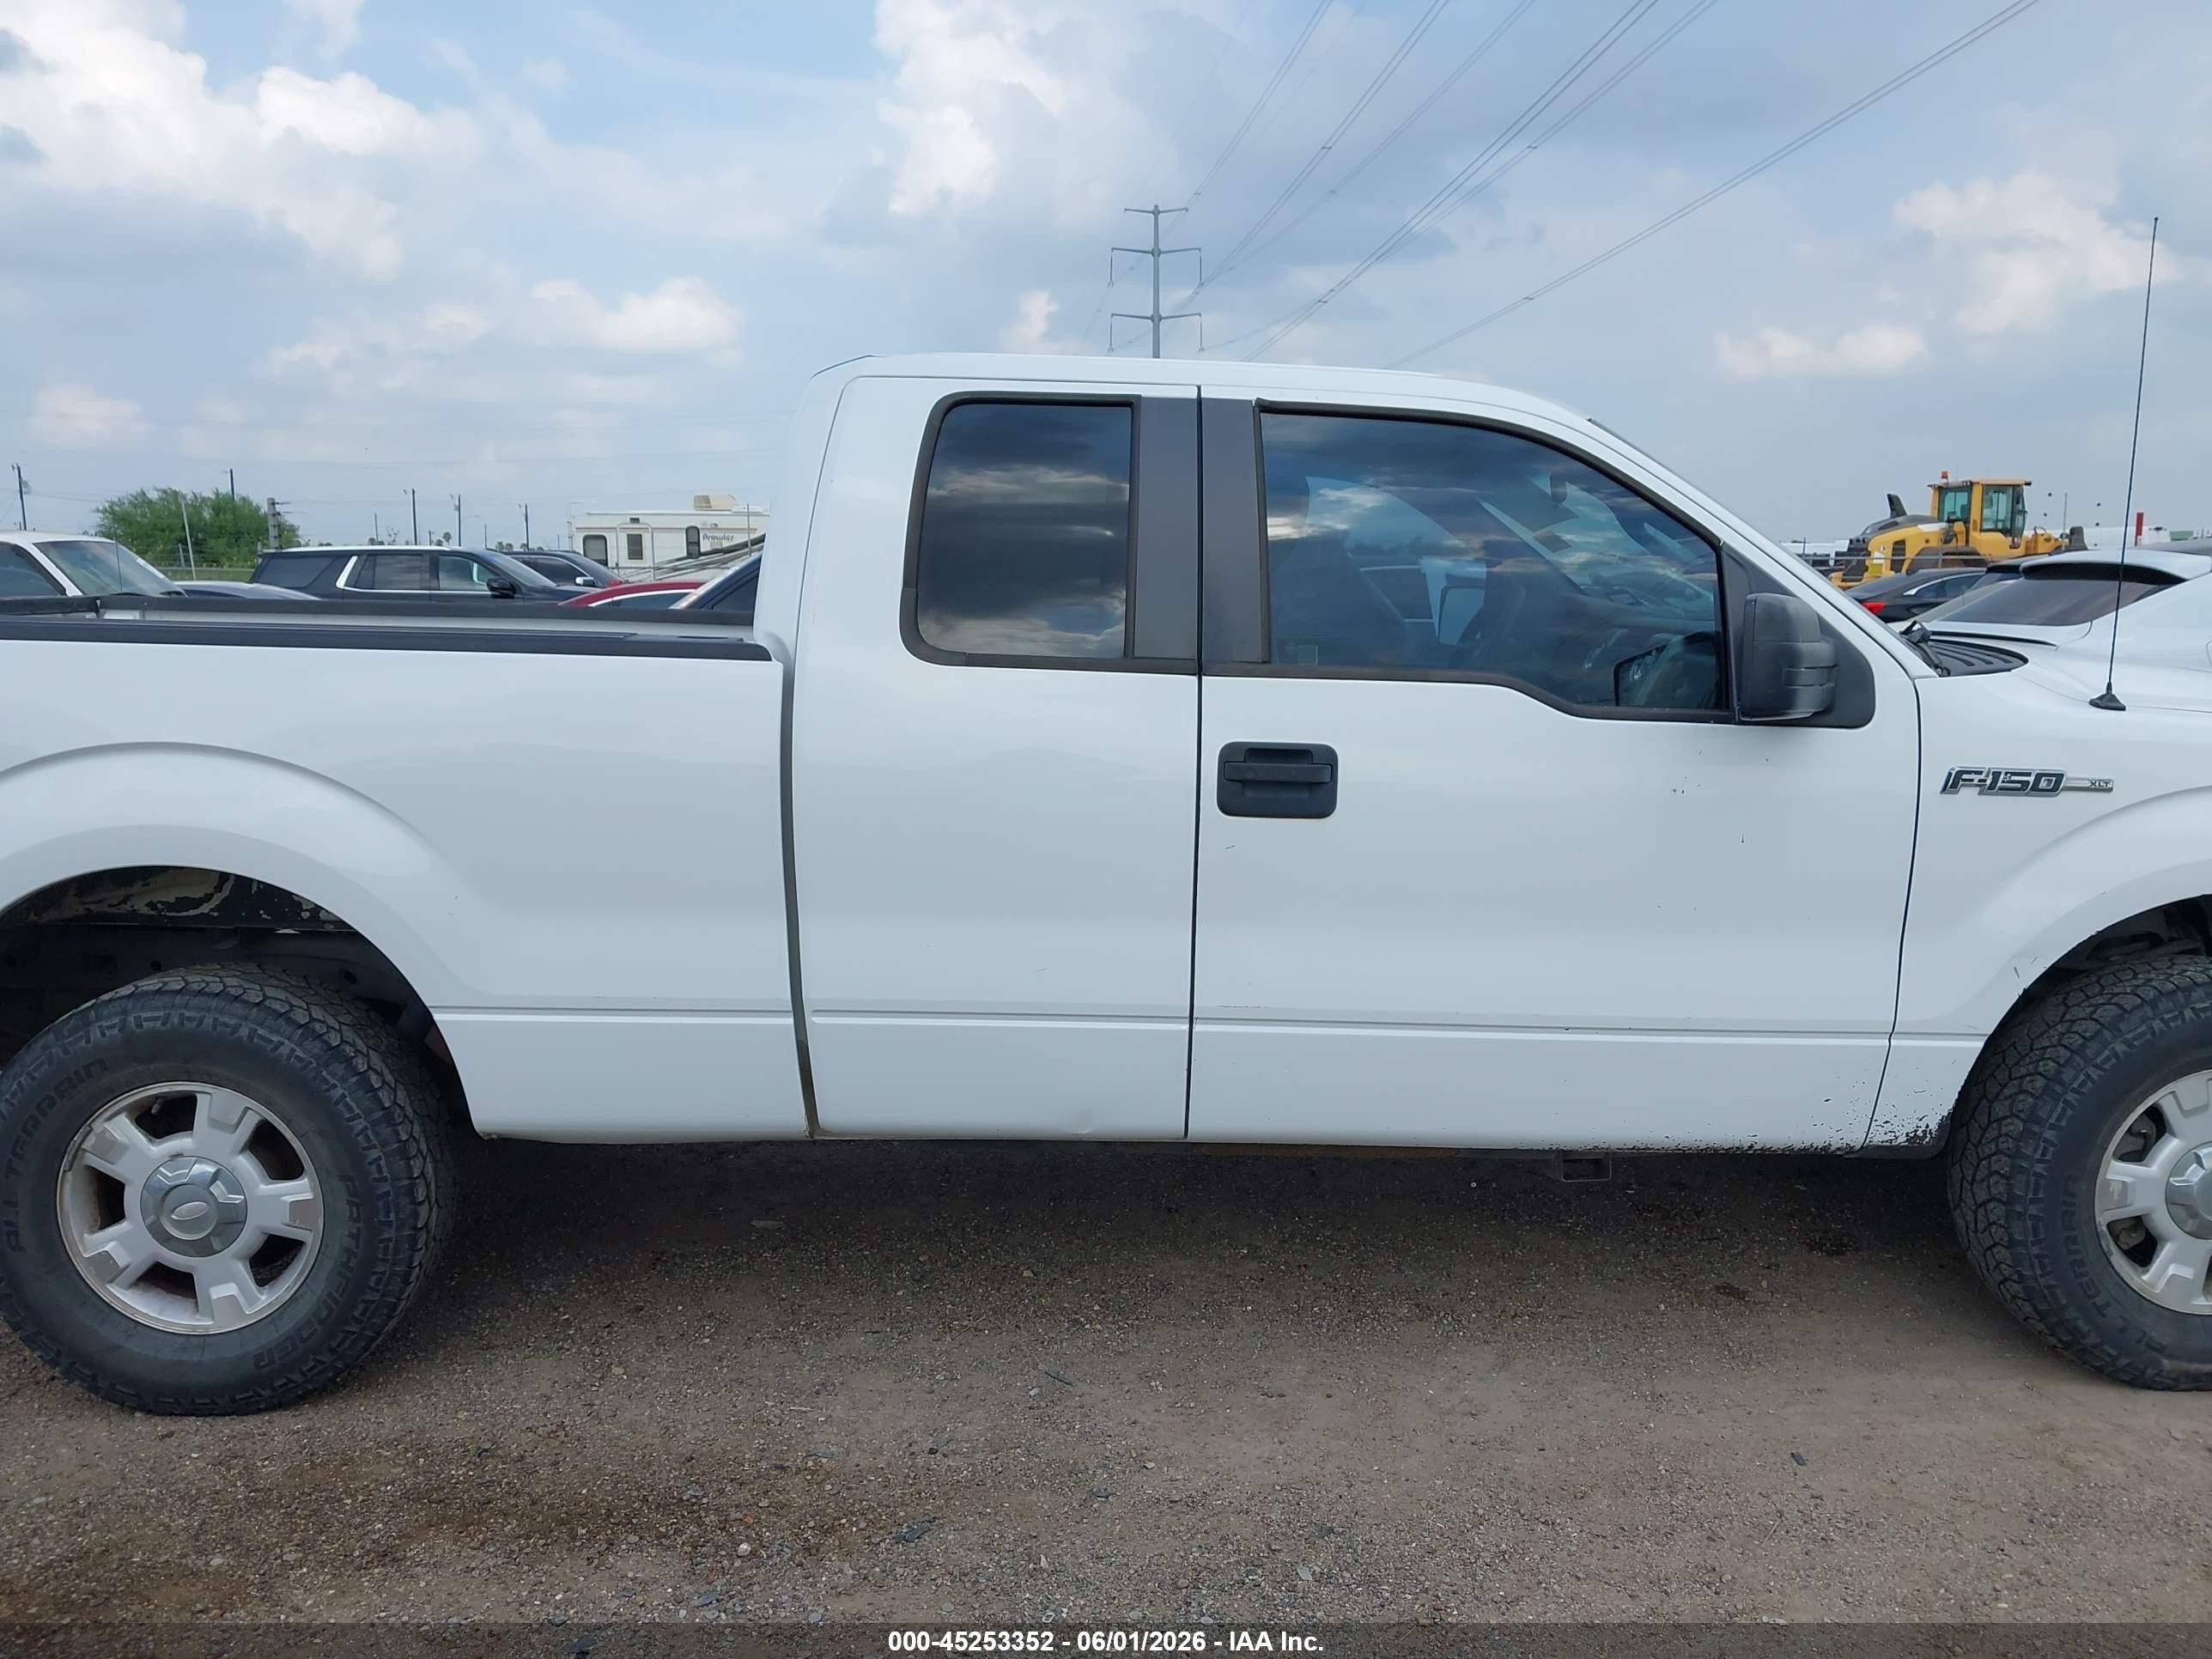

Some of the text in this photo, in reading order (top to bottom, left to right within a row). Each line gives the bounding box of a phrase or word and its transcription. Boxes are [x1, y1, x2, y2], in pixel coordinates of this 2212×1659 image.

[702, 532, 734, 542] Prowler
[1940, 766, 2112, 798] F-150 XLT
[4, 1057, 110, 1182] TERRAIN
[252, 1173, 362, 1370] PATHFINDER
